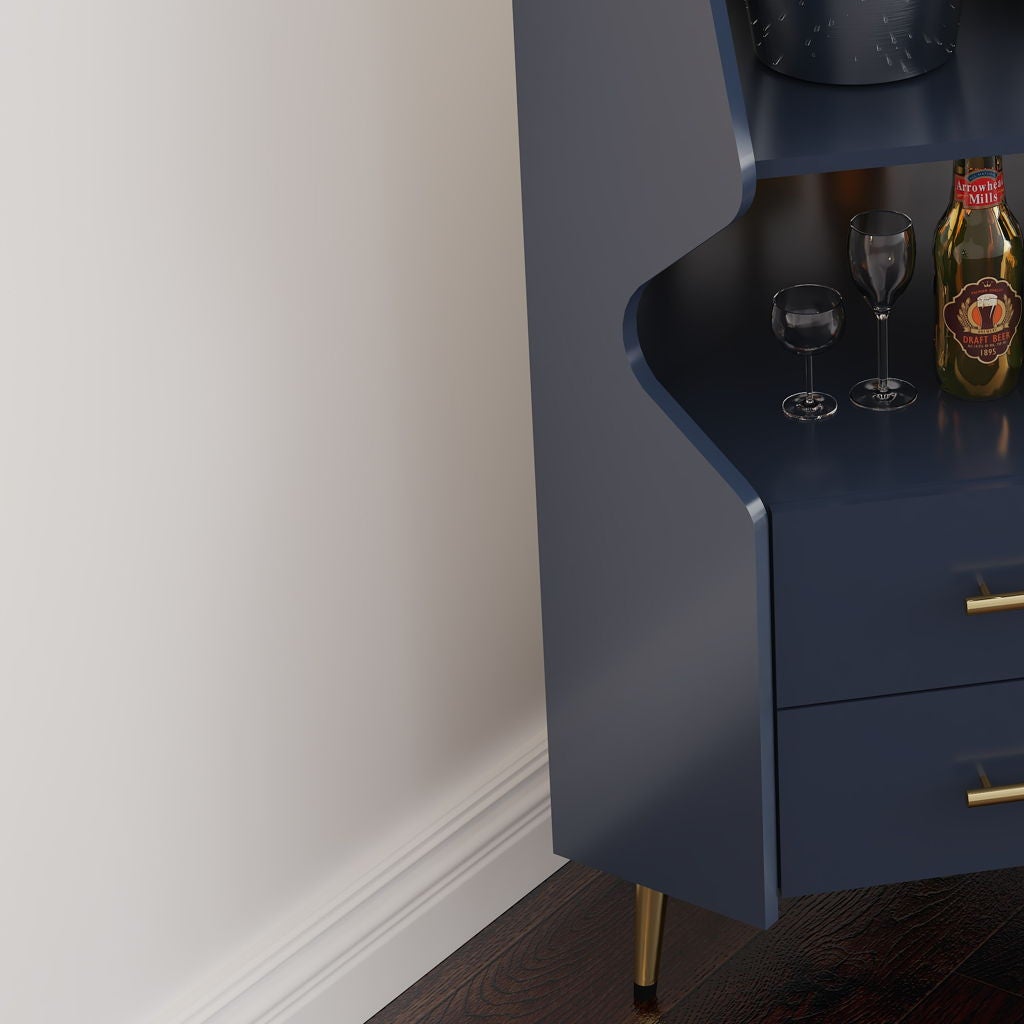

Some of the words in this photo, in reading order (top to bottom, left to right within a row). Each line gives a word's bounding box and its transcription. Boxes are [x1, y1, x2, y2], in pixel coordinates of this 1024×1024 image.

[969, 192, 998, 205] Mills
[963, 335, 989, 345] DRAFT
[992, 331, 1010, 343] BEER
[980, 348, 997, 357] 1895
